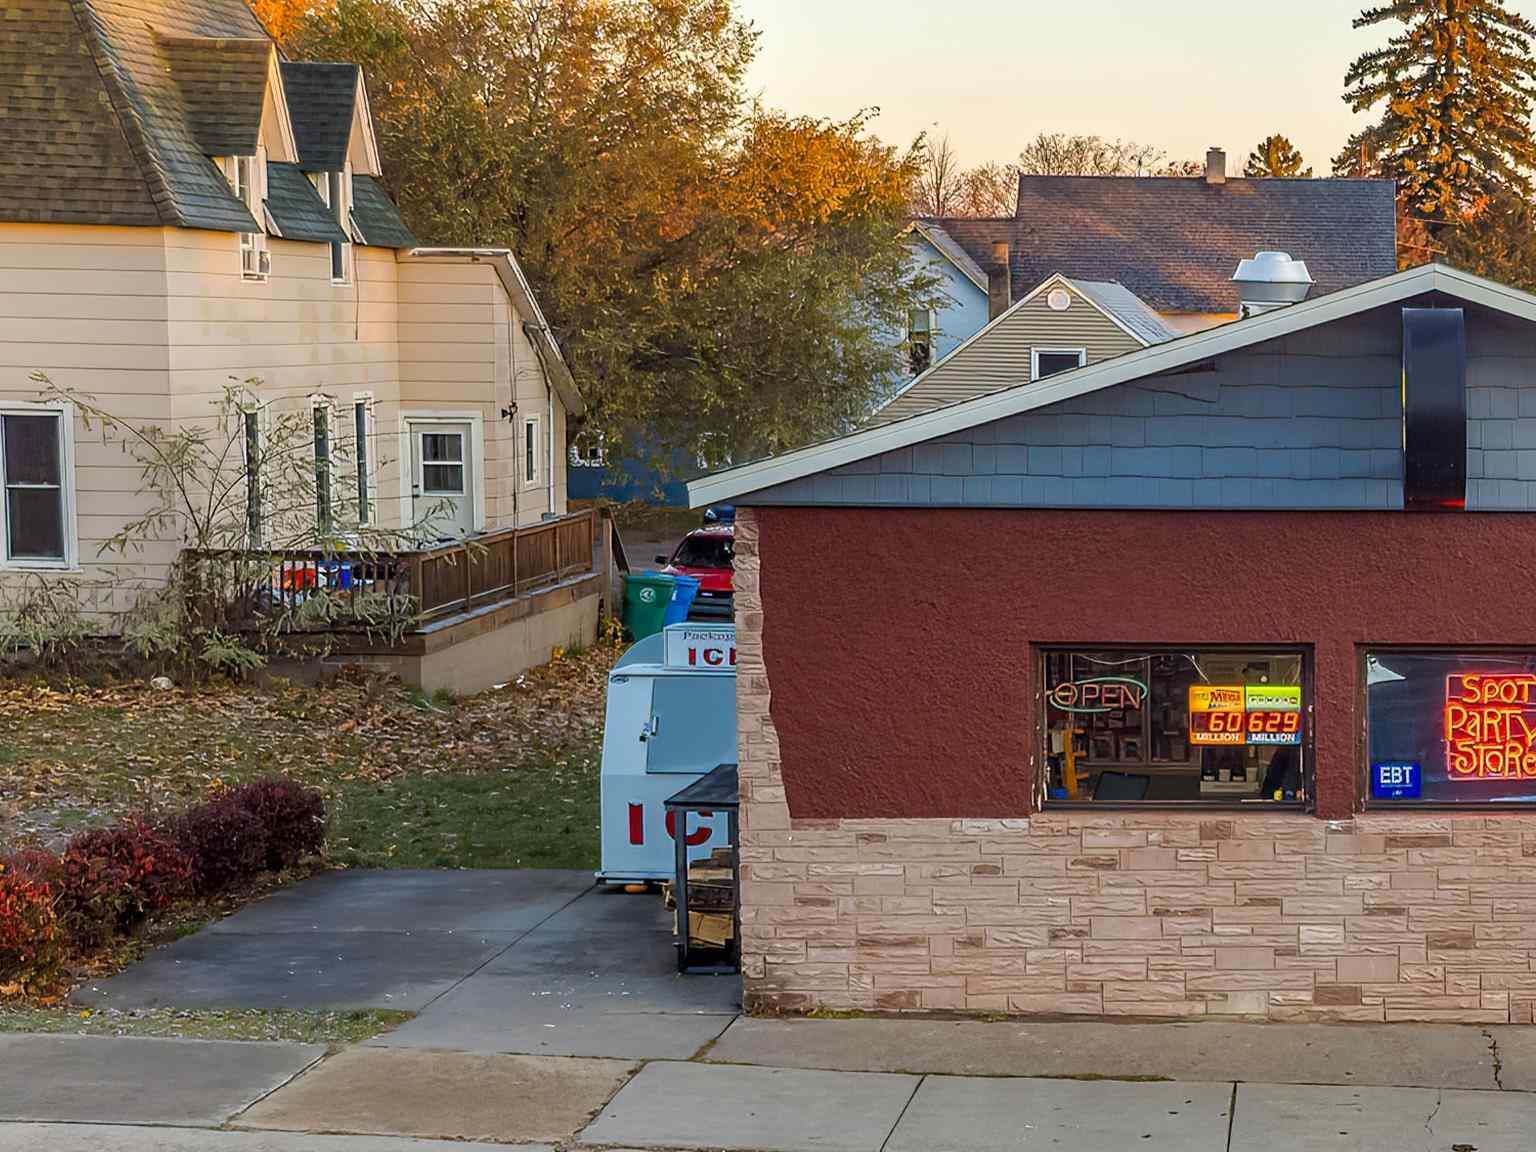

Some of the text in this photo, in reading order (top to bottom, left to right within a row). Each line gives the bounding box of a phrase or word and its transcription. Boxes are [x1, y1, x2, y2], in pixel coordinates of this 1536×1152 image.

[1054, 682, 1140, 709] OPEN
[1462, 674, 1536, 704] SPOT
[1209, 713, 1242, 732] 60
[1248, 713, 1298, 732] 629
[1196, 732, 1239, 741] MILLION
[1251, 733, 1295, 741] MILLION
[1380, 766, 1413, 784] EBT
